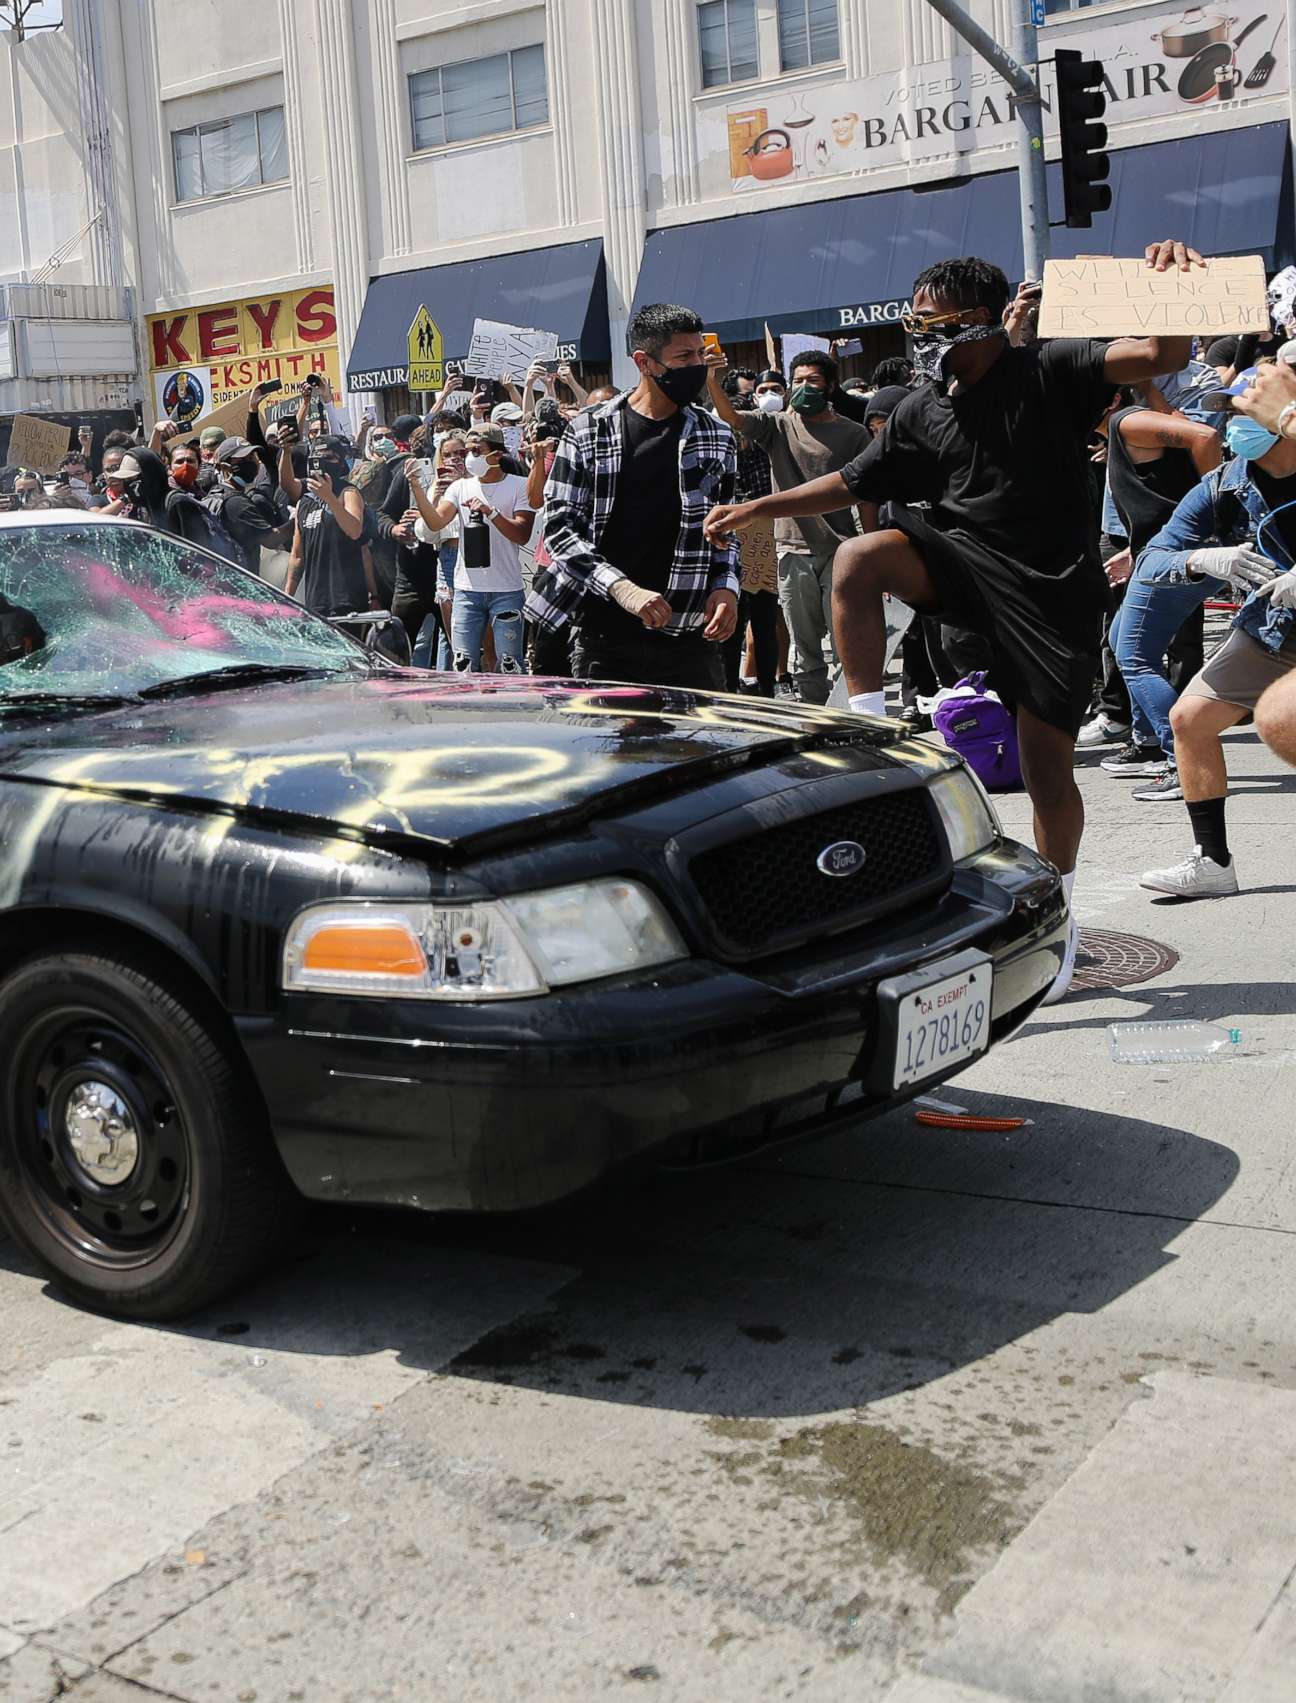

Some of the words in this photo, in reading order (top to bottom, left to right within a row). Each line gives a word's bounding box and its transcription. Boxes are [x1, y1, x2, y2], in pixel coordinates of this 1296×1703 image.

[885, 70, 961, 105] VOTED
[970, 66, 1005, 89] BE
[1100, 62, 1172, 103] AIR
[1057, 279, 1248, 298] SILENCE
[838, 300, 912, 327] BARGA
[1051, 304, 1099, 331] IS
[151, 290, 338, 368] KEYS
[349, 367, 411, 391] RESTAURA
[412, 368, 441, 385] AHEAD
[832, 850, 857, 870] Ford
[920, 999, 933, 1015] CA
[937, 984, 968, 1009] EXEMPT
[903, 999, 984, 1073] 1278169
